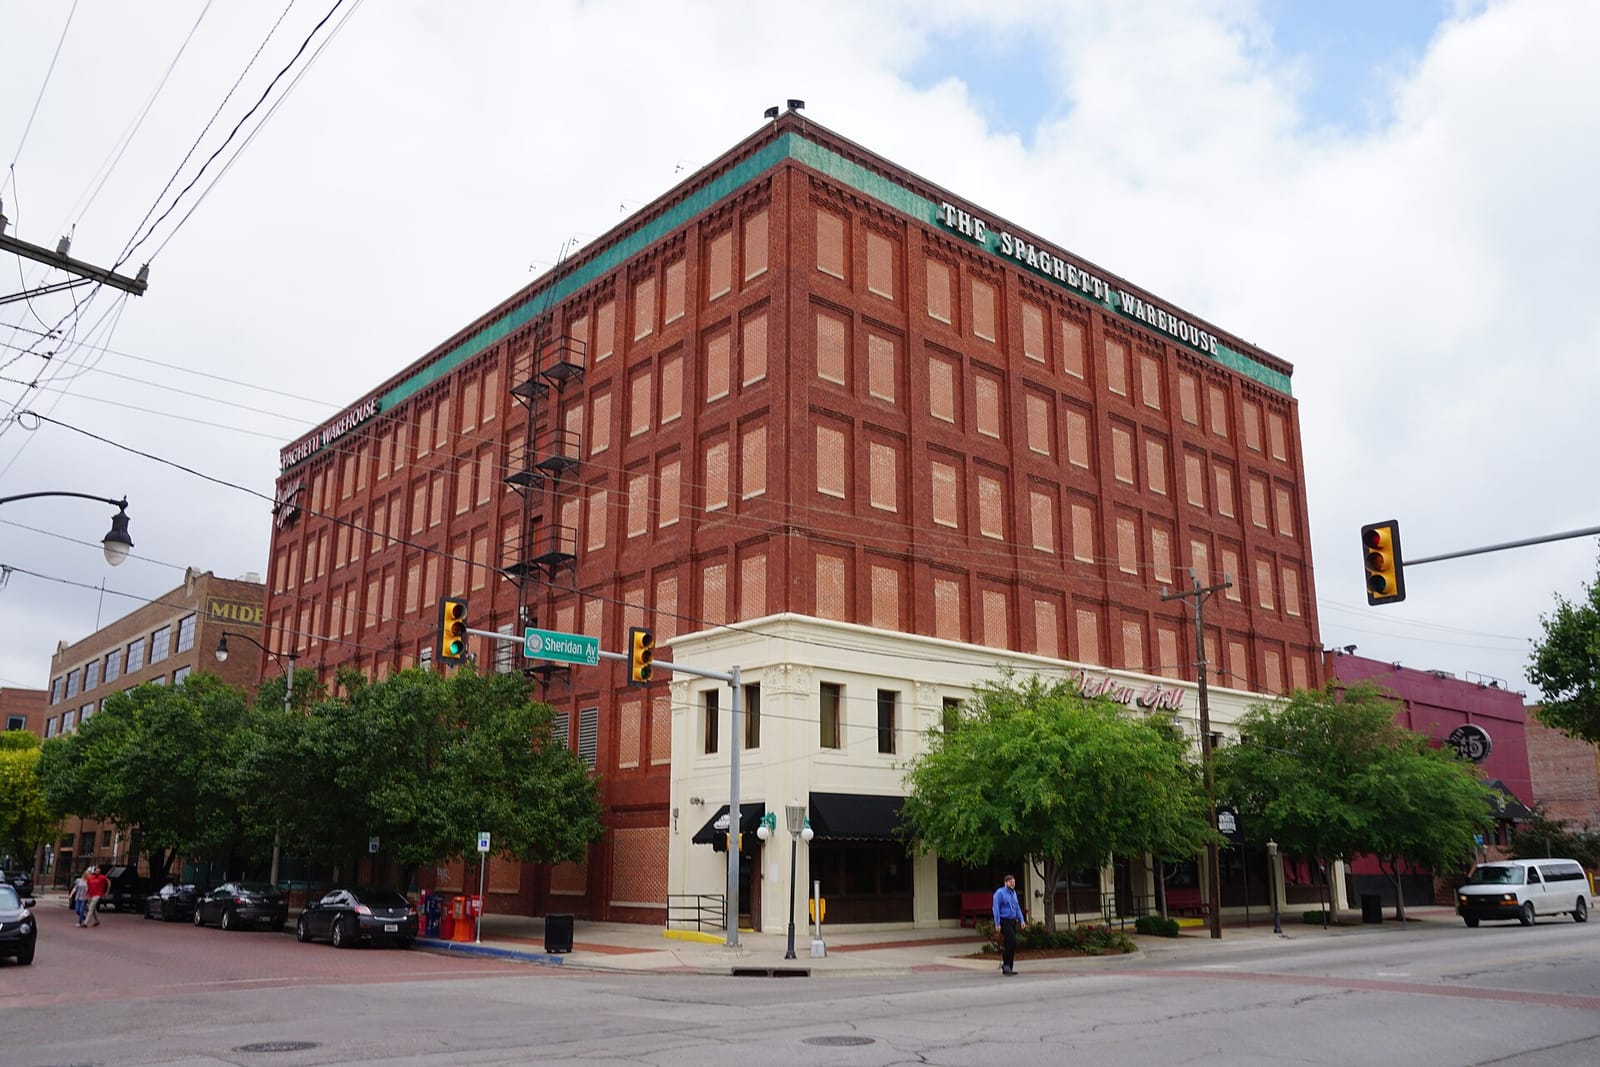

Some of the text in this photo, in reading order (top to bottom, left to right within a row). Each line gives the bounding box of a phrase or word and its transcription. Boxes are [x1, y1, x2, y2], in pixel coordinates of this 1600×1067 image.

[943, 201, 1219, 357] THE SPAGHETTI WAREHOUSE
[322, 398, 378, 446] WAREHOUSE
[545, 637, 582, 655] Sheridan
